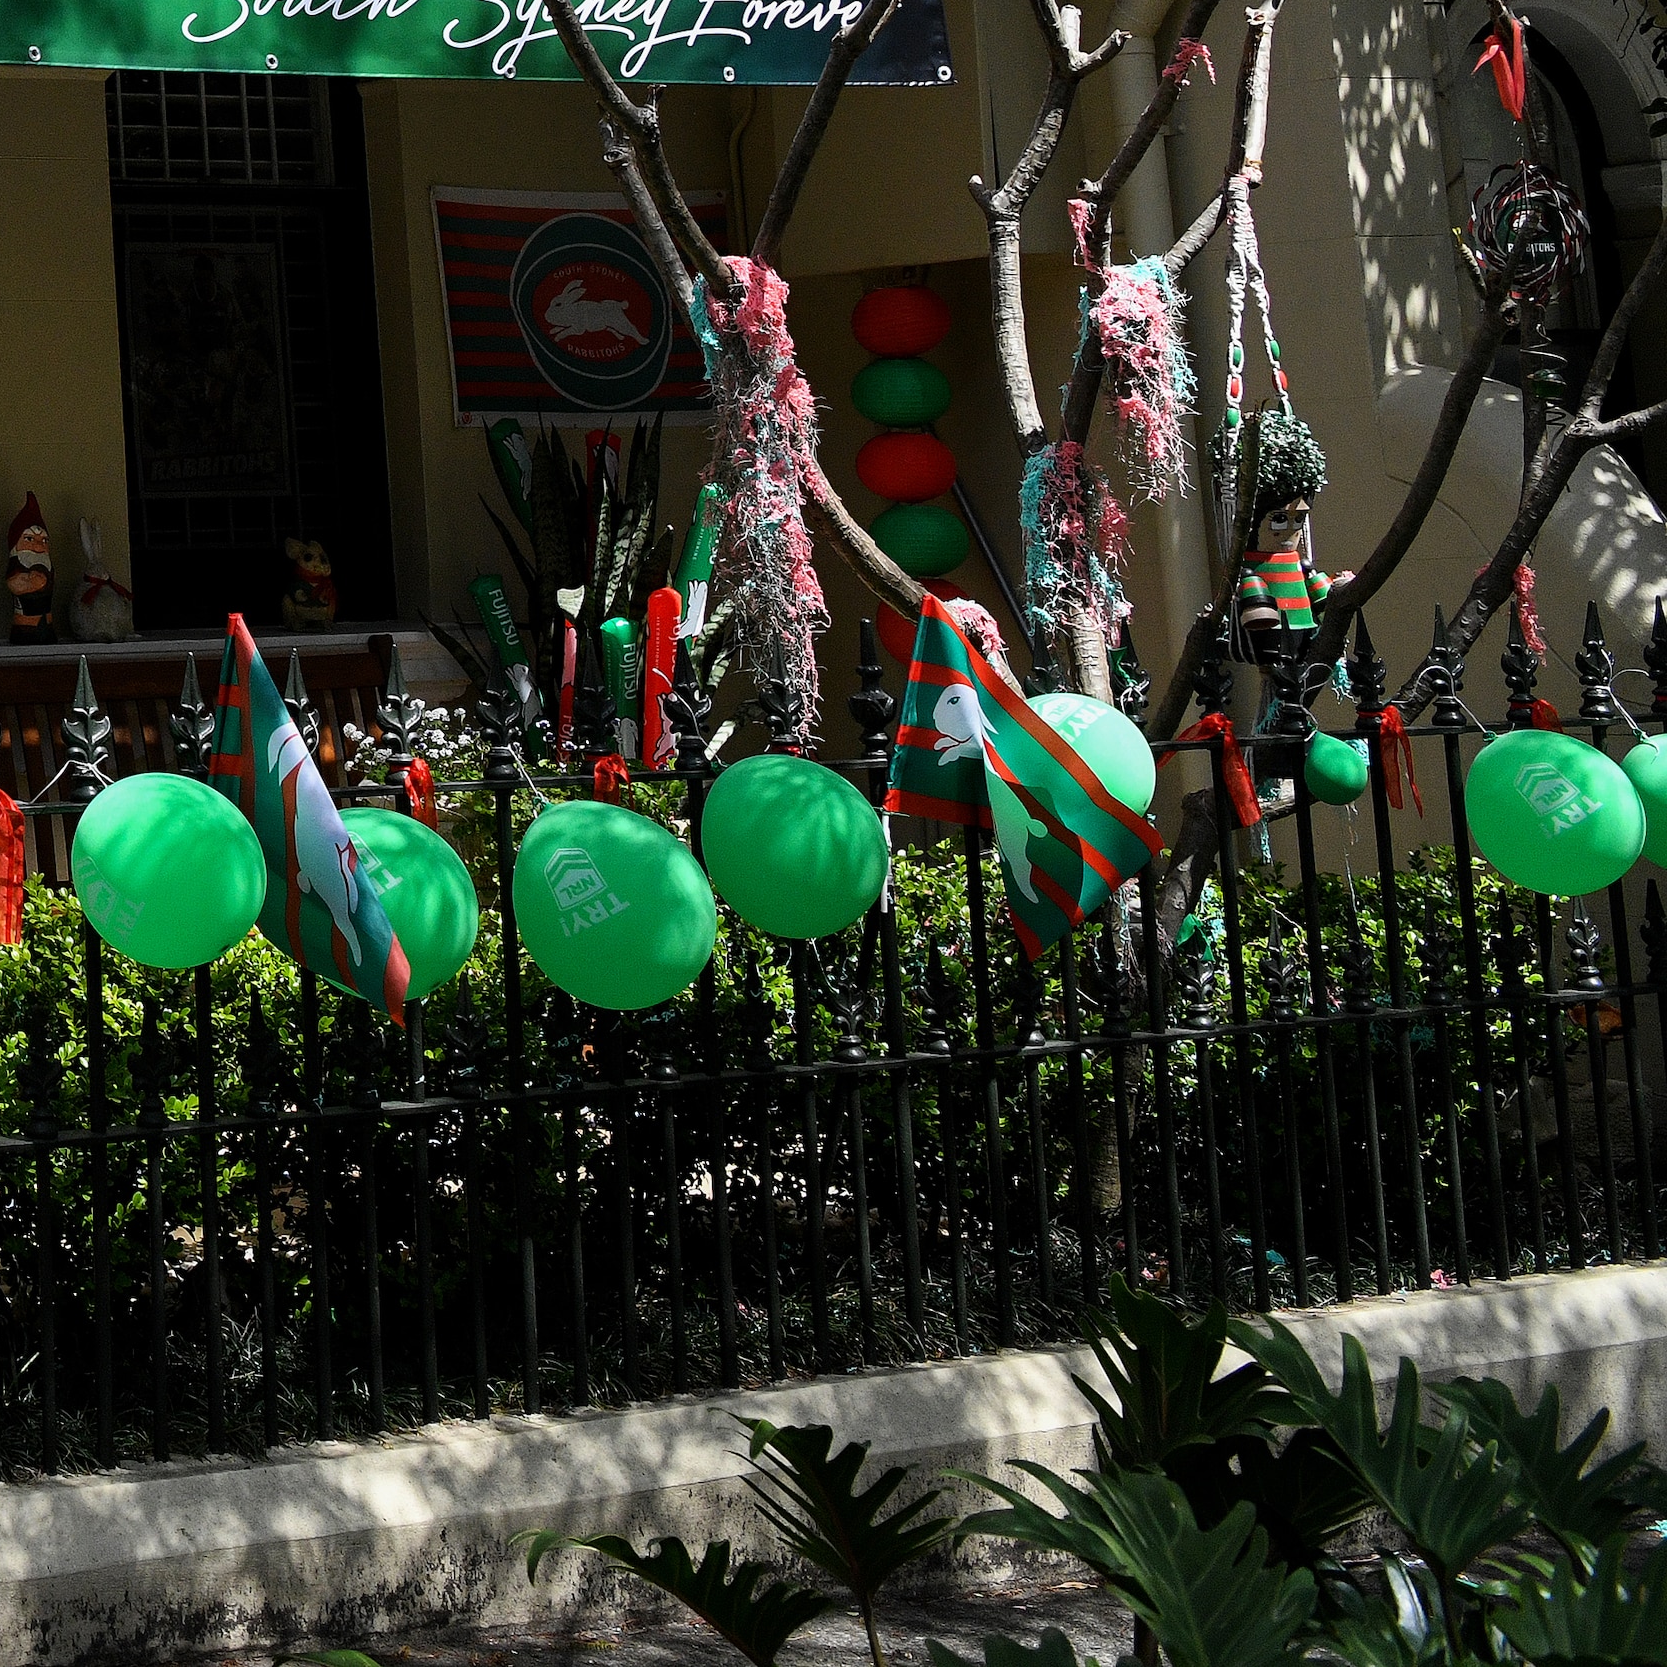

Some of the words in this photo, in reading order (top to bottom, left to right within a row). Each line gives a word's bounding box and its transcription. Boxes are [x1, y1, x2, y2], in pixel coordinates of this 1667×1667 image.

[552, 265, 583, 280] SOUTH
[588, 265, 627, 283] SYDNEY
[567, 342, 626, 358] RABBITOHS
[488, 588, 520, 646] FUJITSU
[622, 643, 637, 701] FUJITSU
[1535, 783, 1570, 806] NRL
[558, 874, 597, 901] NRL
[557, 892, 631, 937] TRY!
